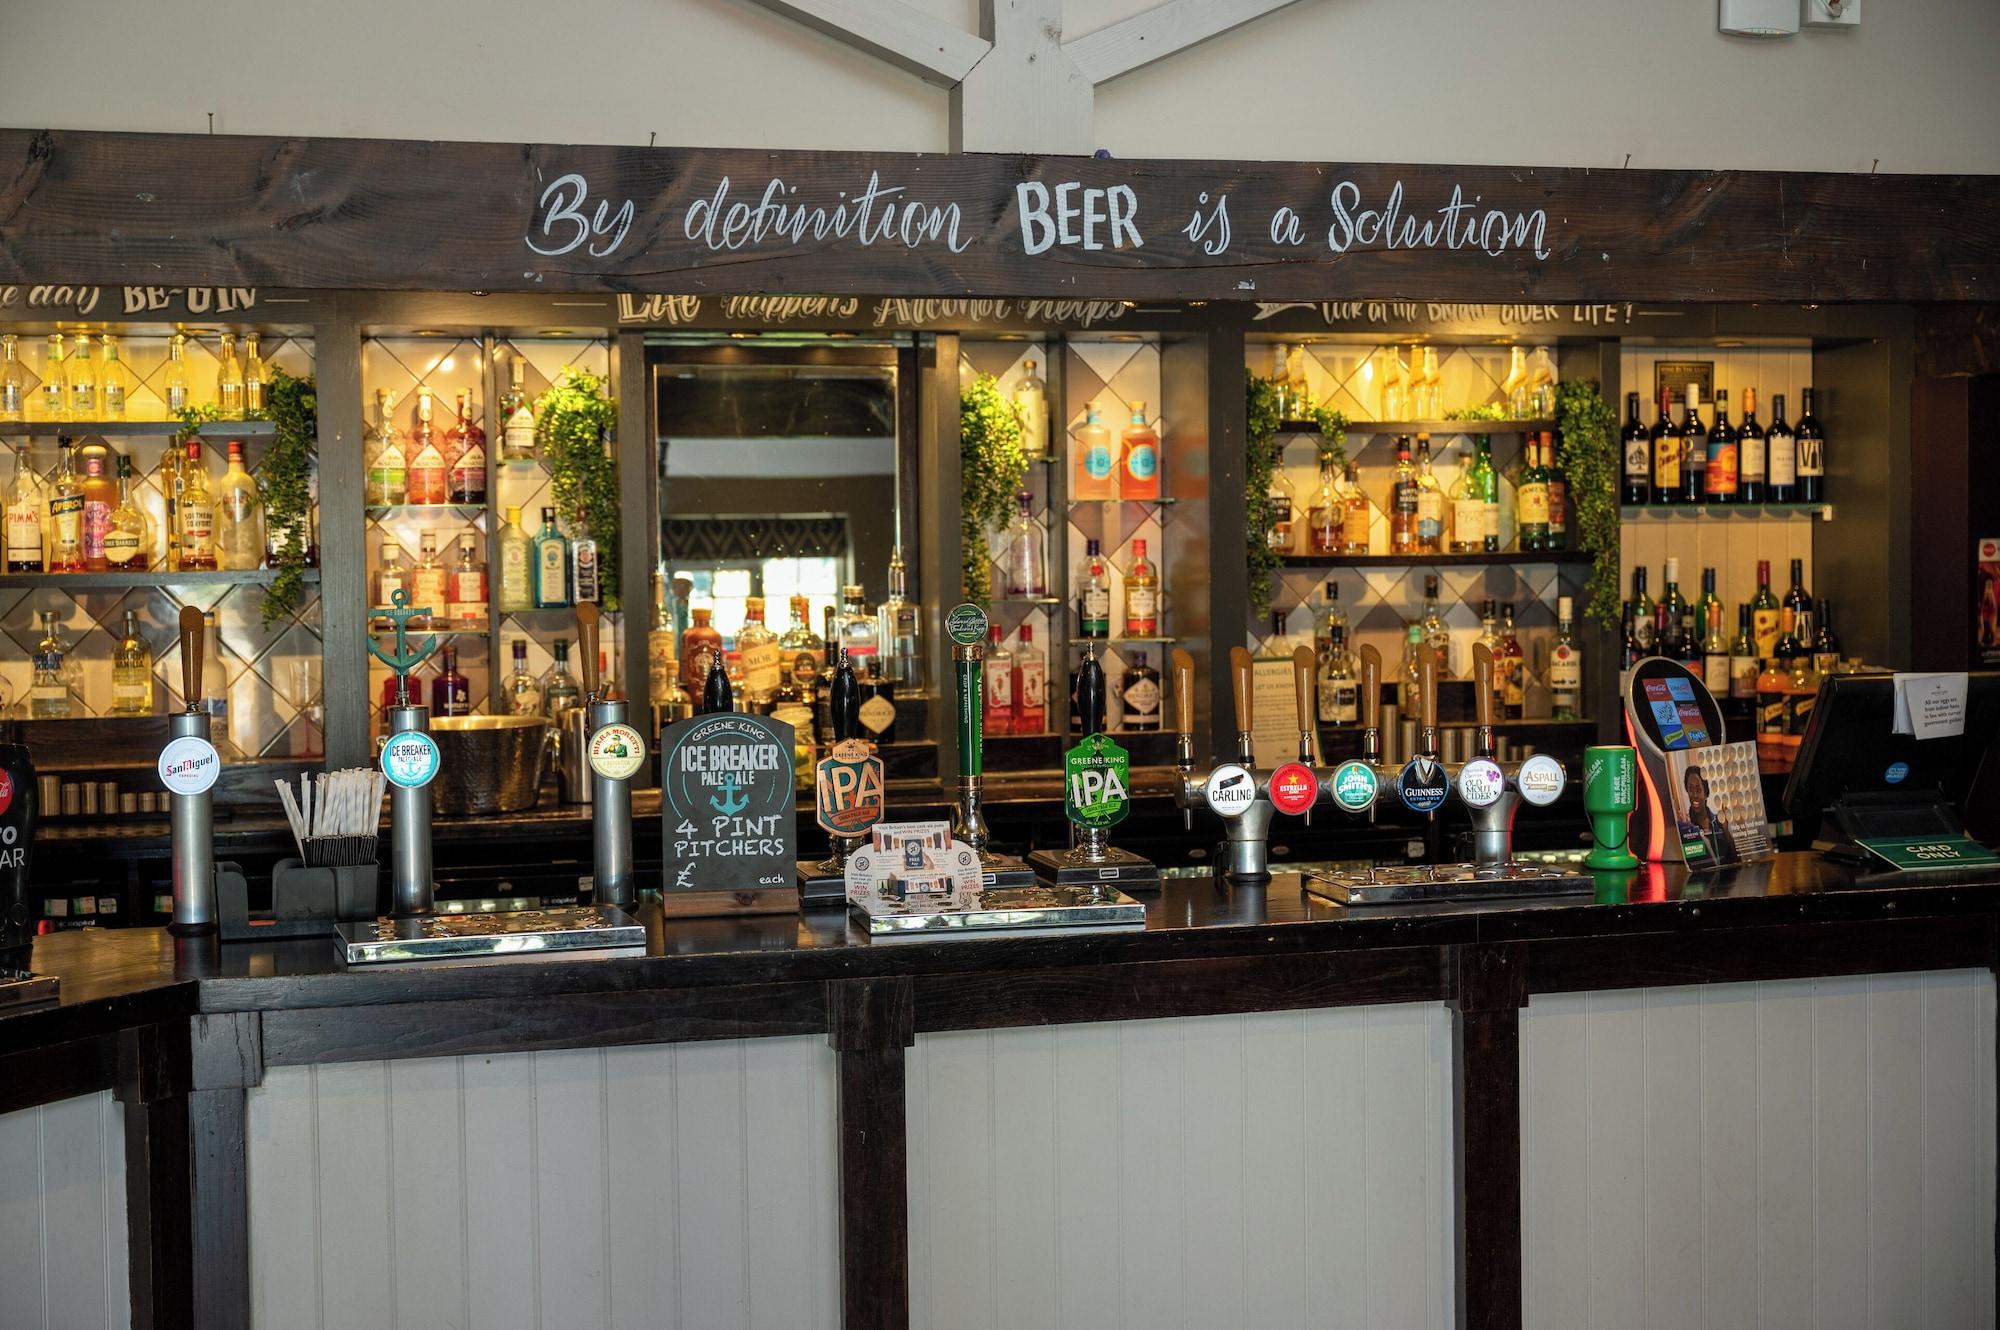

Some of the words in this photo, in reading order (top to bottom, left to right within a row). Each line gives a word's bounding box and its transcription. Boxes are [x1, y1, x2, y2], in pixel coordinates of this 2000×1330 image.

[524, 173, 635, 257] By
[683, 169, 973, 254] definition
[1016, 181, 1144, 256] BEER
[1181, 191, 1232, 256] is
[1270, 206, 1305, 246] a
[1328, 180, 1551, 260] Solution
[0, 286, 18, 306] e
[8, 511, 39, 523] PIMM'S
[1254, 668, 1292, 676] ALLERGIES
[692, 721, 735, 742] GREENE
[738, 721, 766, 740] KING
[593, 731, 611, 755] BIRRA
[612, 729, 640, 754] MORETTI
[389, 745, 400, 756] ICE
[401, 744, 432, 756] BREAKER
[681, 745, 706, 772] ICE
[709, 744, 779, 771] BREAKER
[1071, 757, 1103, 765] GREENE
[1105, 756, 1125, 764] KING
[701, 771, 724, 786] PALE
[735, 770, 755, 785] ALE
[1342, 774, 1368, 784] JOHN
[1465, 779, 1483, 788] OLD
[1524, 770, 1560, 784] ASPALL
[817, 762, 882, 813] IPA
[1070, 767, 1128, 809] IPA
[1279, 784, 1308, 792] ESTRELLA
[1338, 782, 1374, 795] SMITH'S
[1405, 787, 1444, 797] GUINNESS
[1212, 788, 1252, 802] CARLING
[1466, 791, 1492, 800] CIDER
[675, 818, 698, 840] 4
[711, 814, 782, 838] PINT
[0, 826, 17, 845] O
[674, 838, 785, 858] PITCHERS
[1906, 844, 1951, 853] CARD
[1917, 850, 1961, 859] ONLY
[675, 861, 697, 888] £
[759, 873, 785, 885] each
